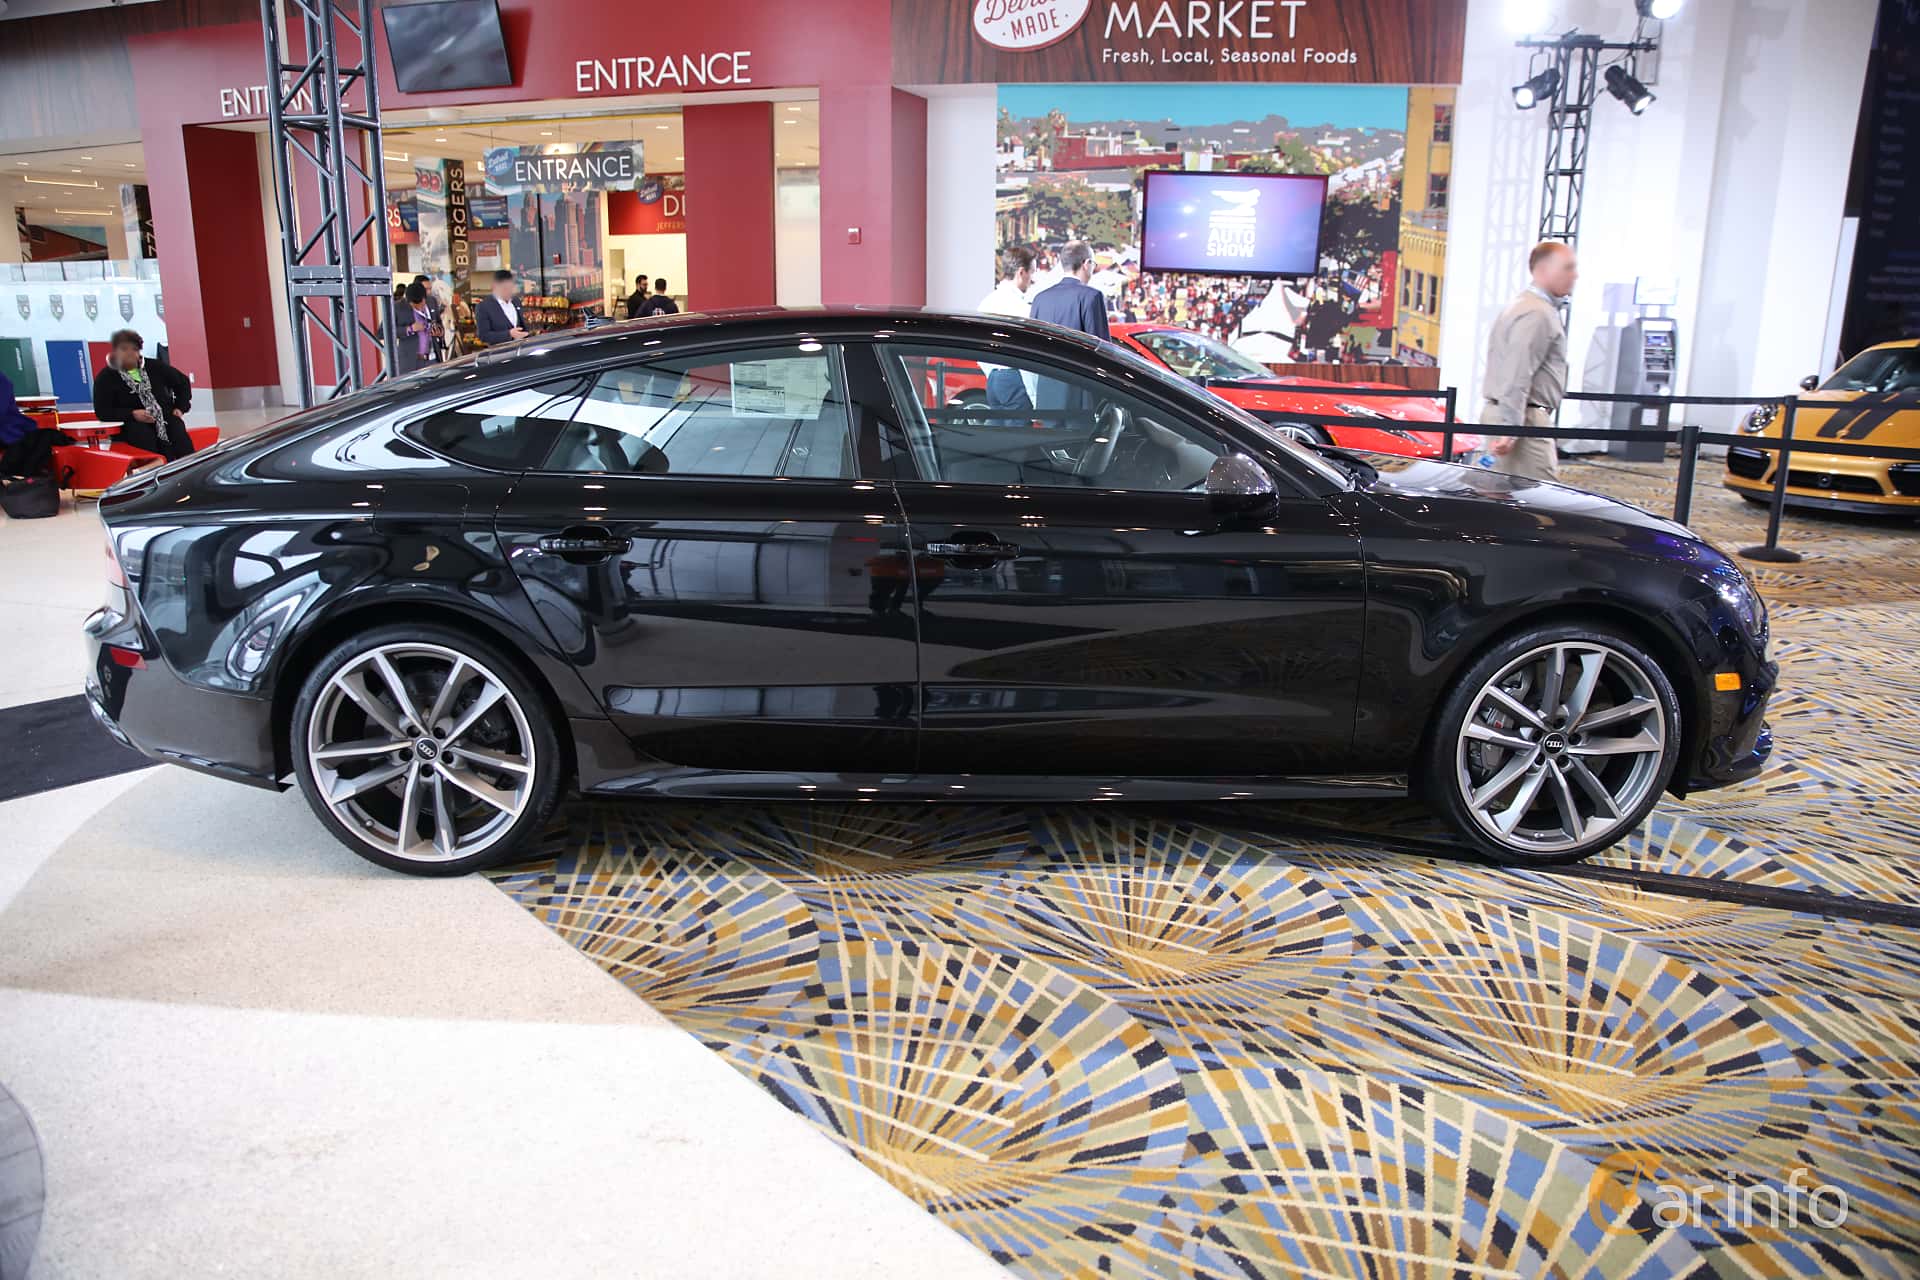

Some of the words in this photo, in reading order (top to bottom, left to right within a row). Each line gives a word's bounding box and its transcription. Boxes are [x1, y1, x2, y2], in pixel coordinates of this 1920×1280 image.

[1010, 8, 1060, 40] MADE
[1104, 1, 1307, 39] MARKET
[1102, 48, 1155, 65] Fresh,
[1161, 48, 1214, 65] Local,
[1220, 48, 1297, 64] Seasonal
[1303, 48, 1358, 64] Foods
[576, 51, 751, 92] ENTRANCE
[515, 156, 631, 182] ENTRANCE
[451, 167, 469, 265] BURGERS
[1206, 242, 1255, 257] SHOW
[1208, 228, 1256, 243] AUTO
